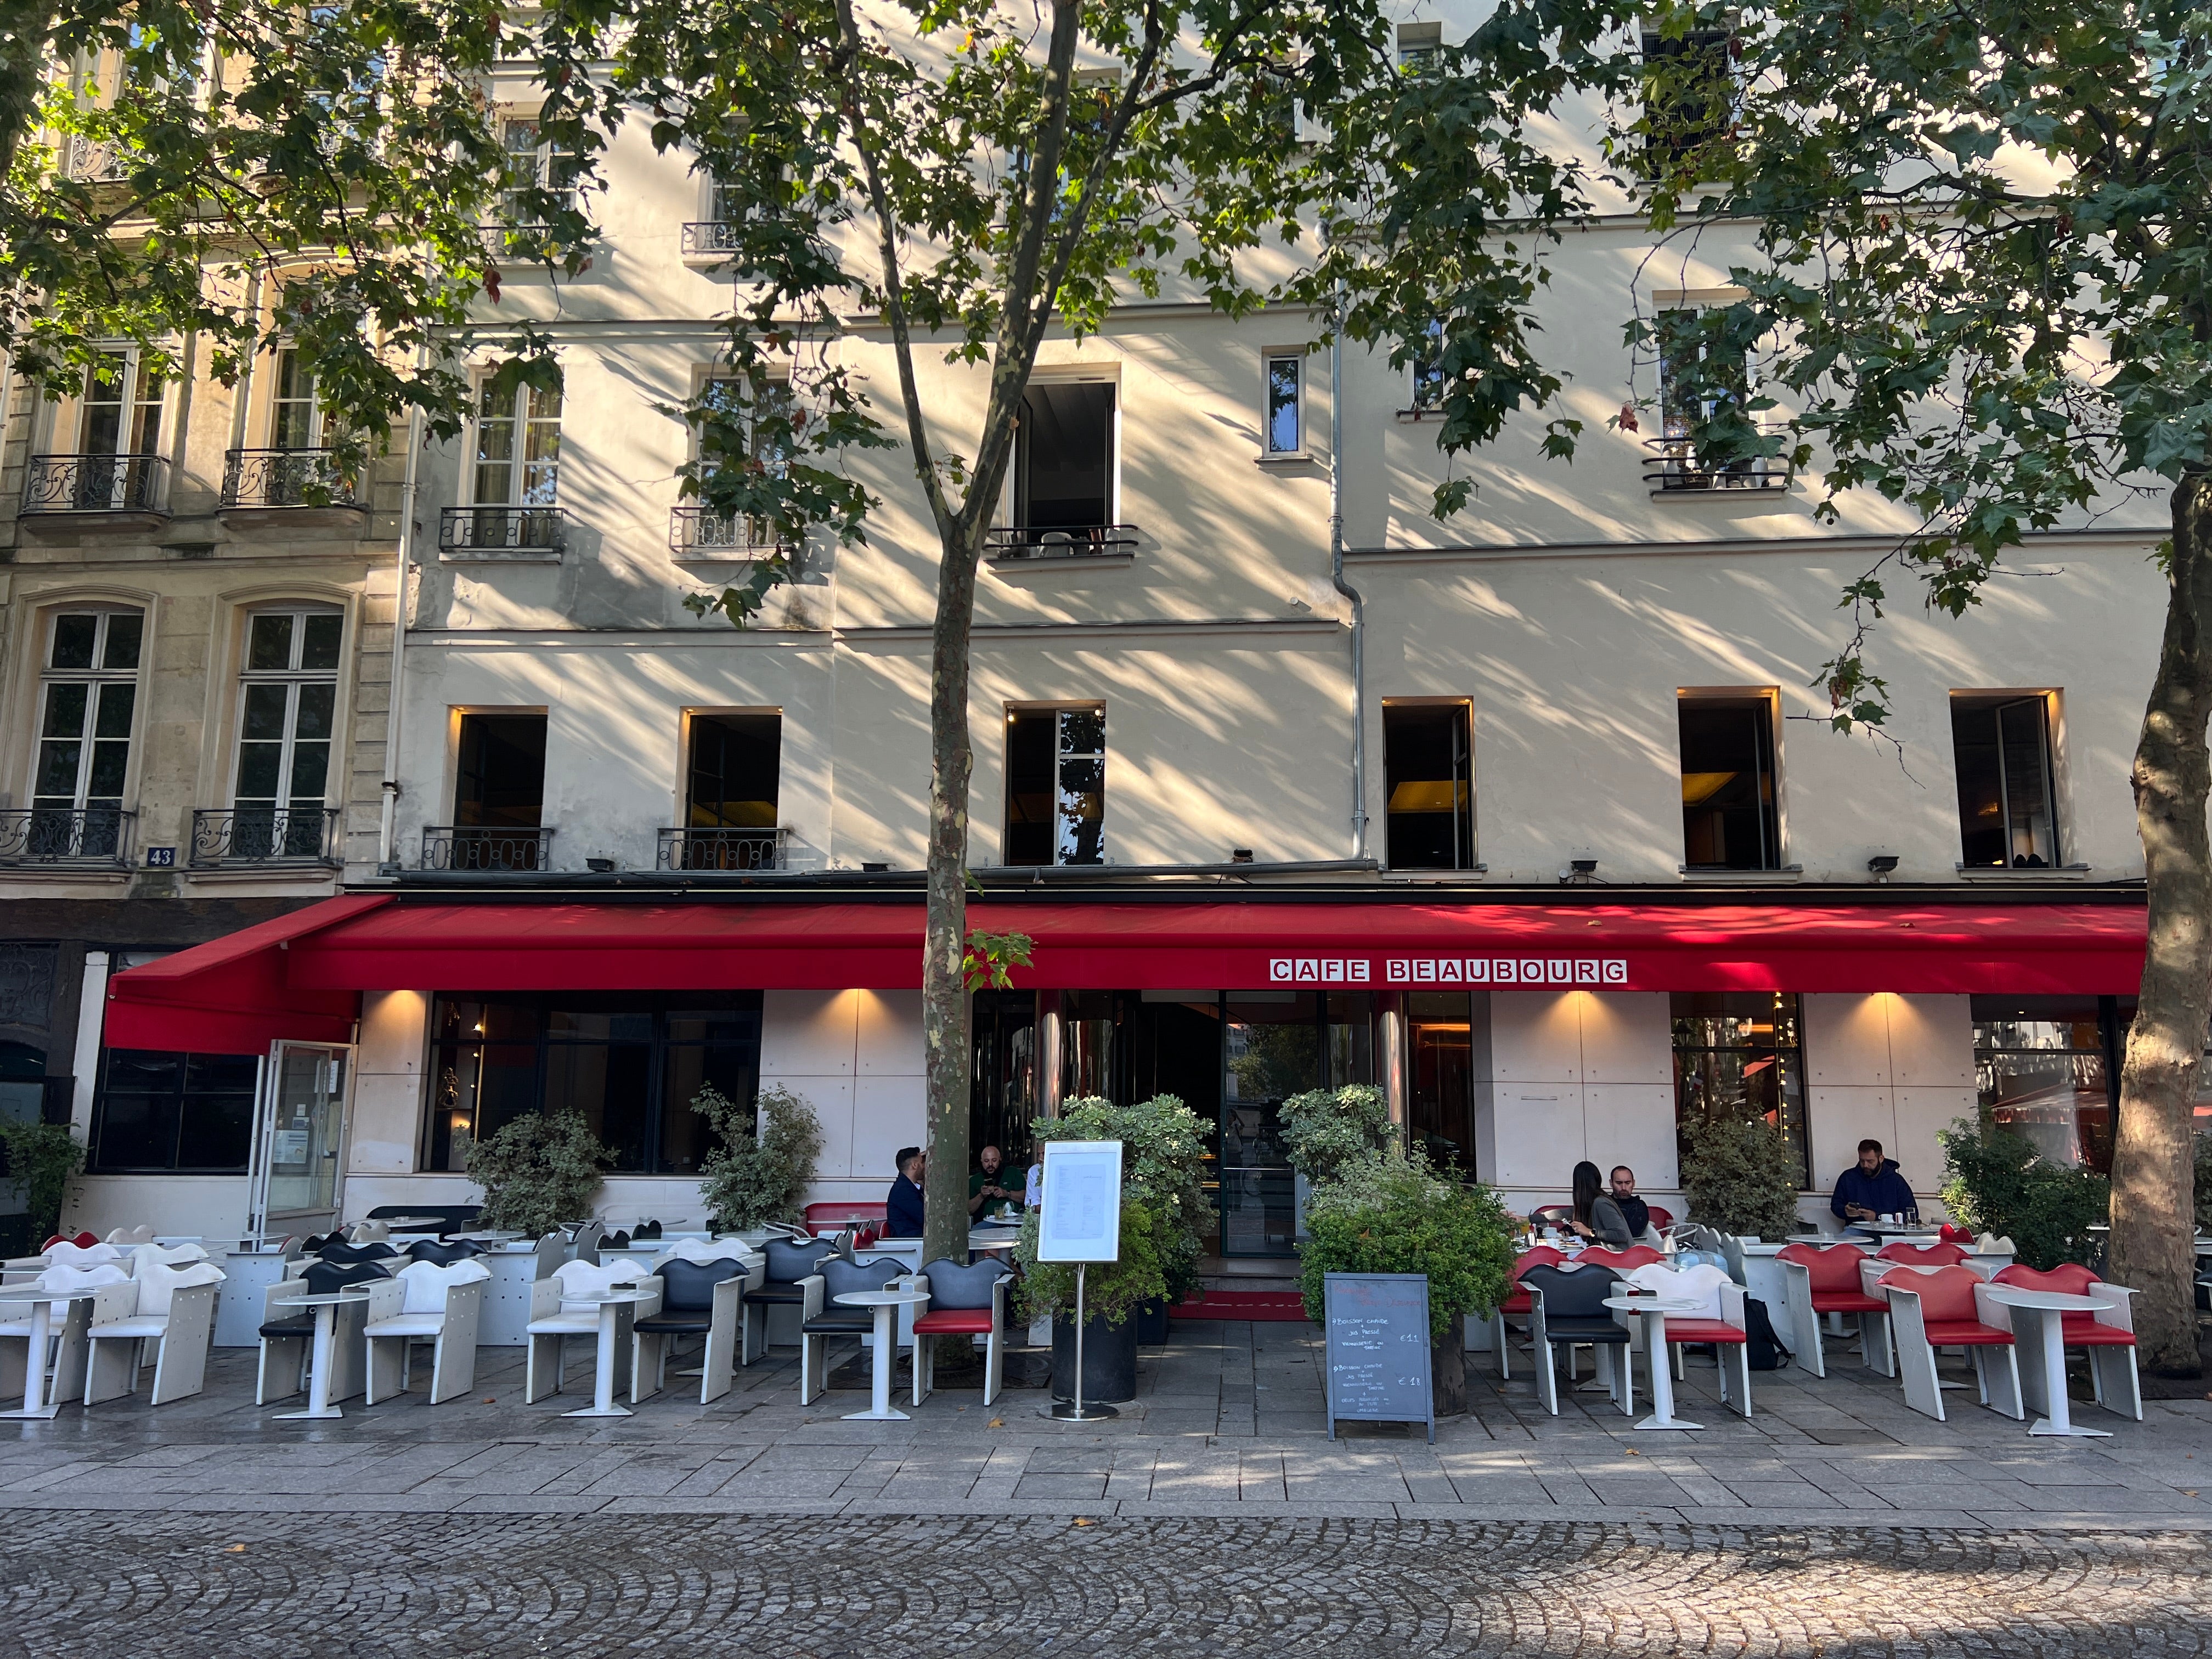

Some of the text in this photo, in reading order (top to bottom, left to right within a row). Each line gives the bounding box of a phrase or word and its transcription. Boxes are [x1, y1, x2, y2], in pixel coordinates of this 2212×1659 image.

[150, 850, 171, 865] 43
[1273, 961, 1624, 981] CAFE BEAUBOURG
